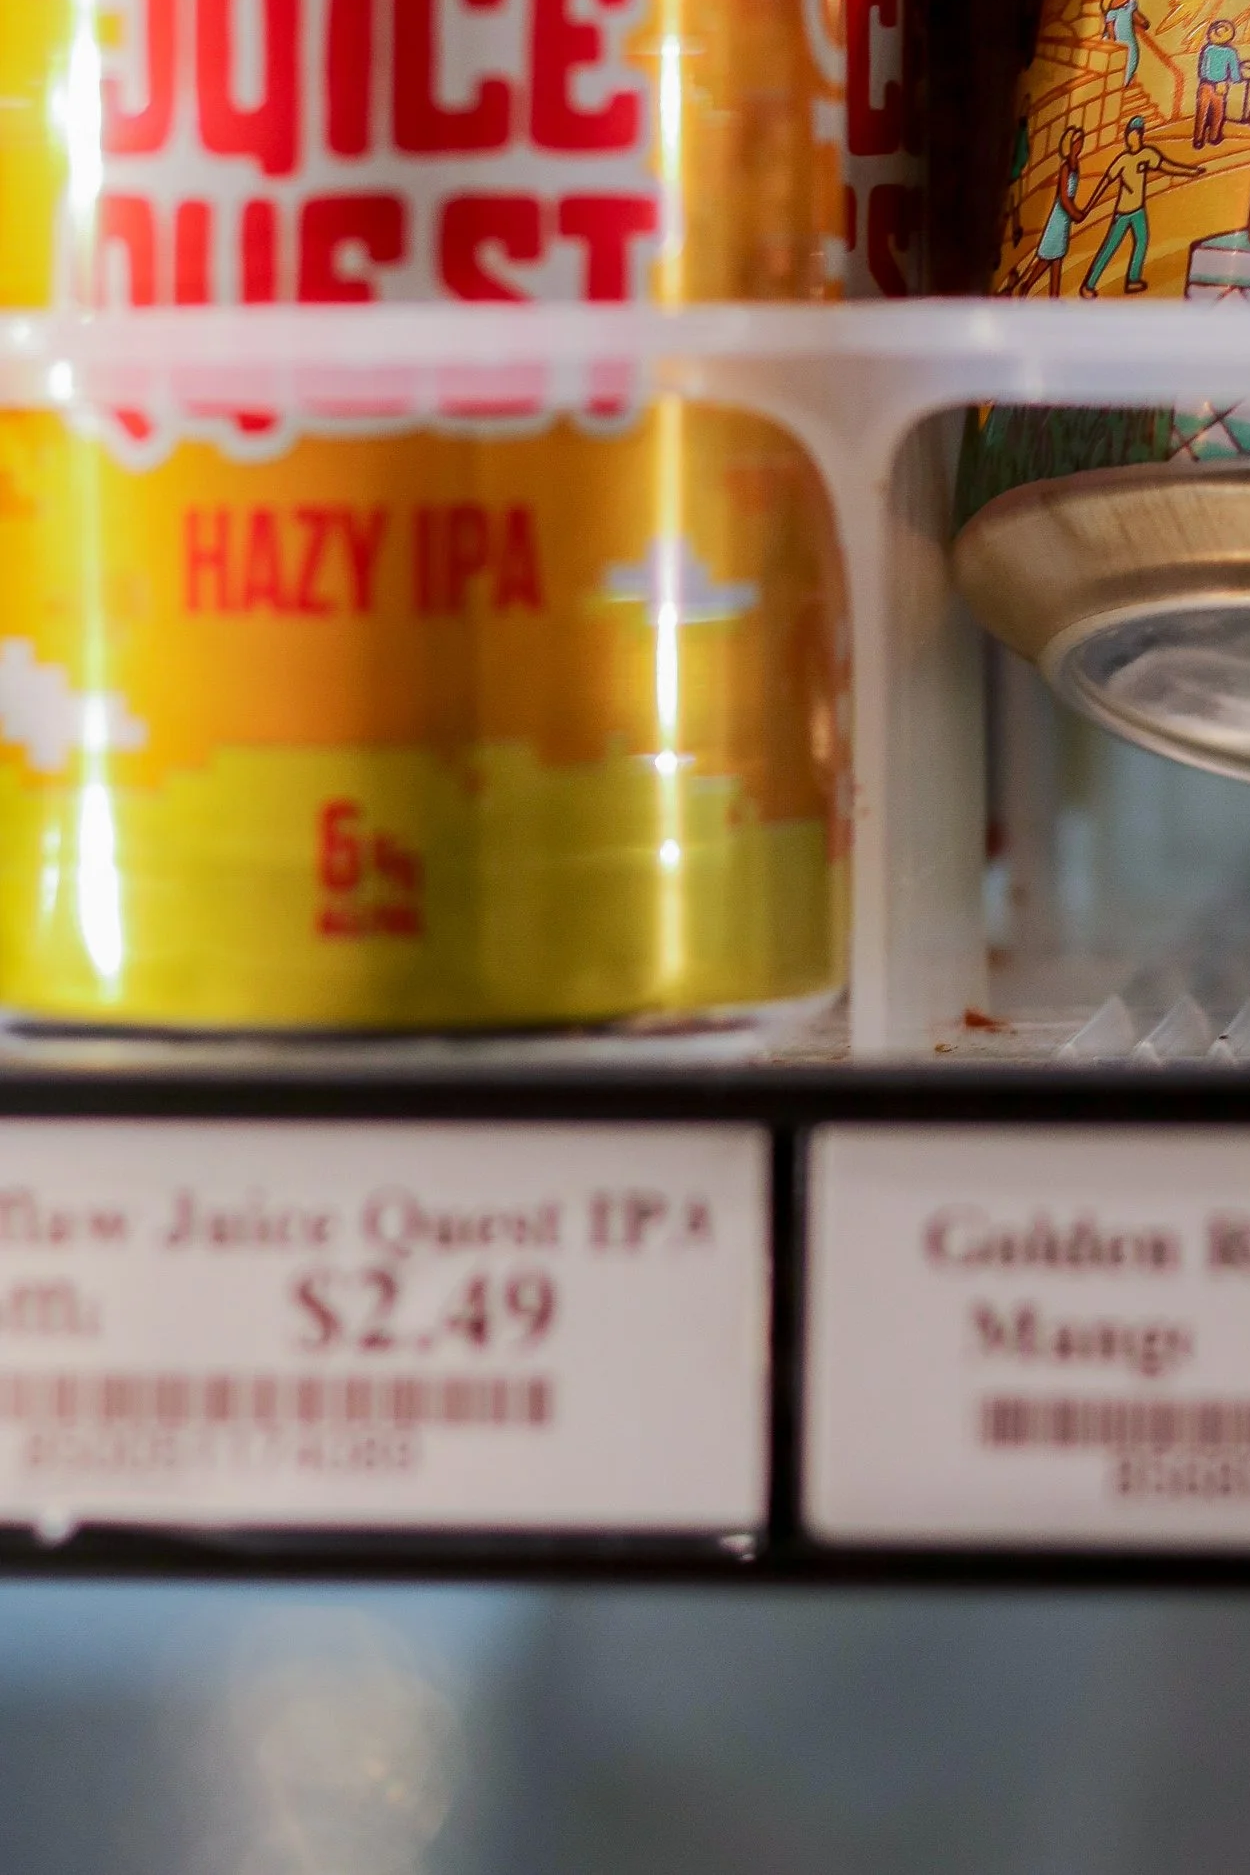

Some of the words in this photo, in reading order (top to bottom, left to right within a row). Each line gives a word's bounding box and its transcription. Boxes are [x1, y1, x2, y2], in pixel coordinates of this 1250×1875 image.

[184, 502, 387, 618] HAZY
[412, 500, 544, 618] IPA
[926, 1207, 1180, 1273] Golden
[290, 1267, 558, 1353] $2.49
[972, 1303, 1194, 1377] Mango
